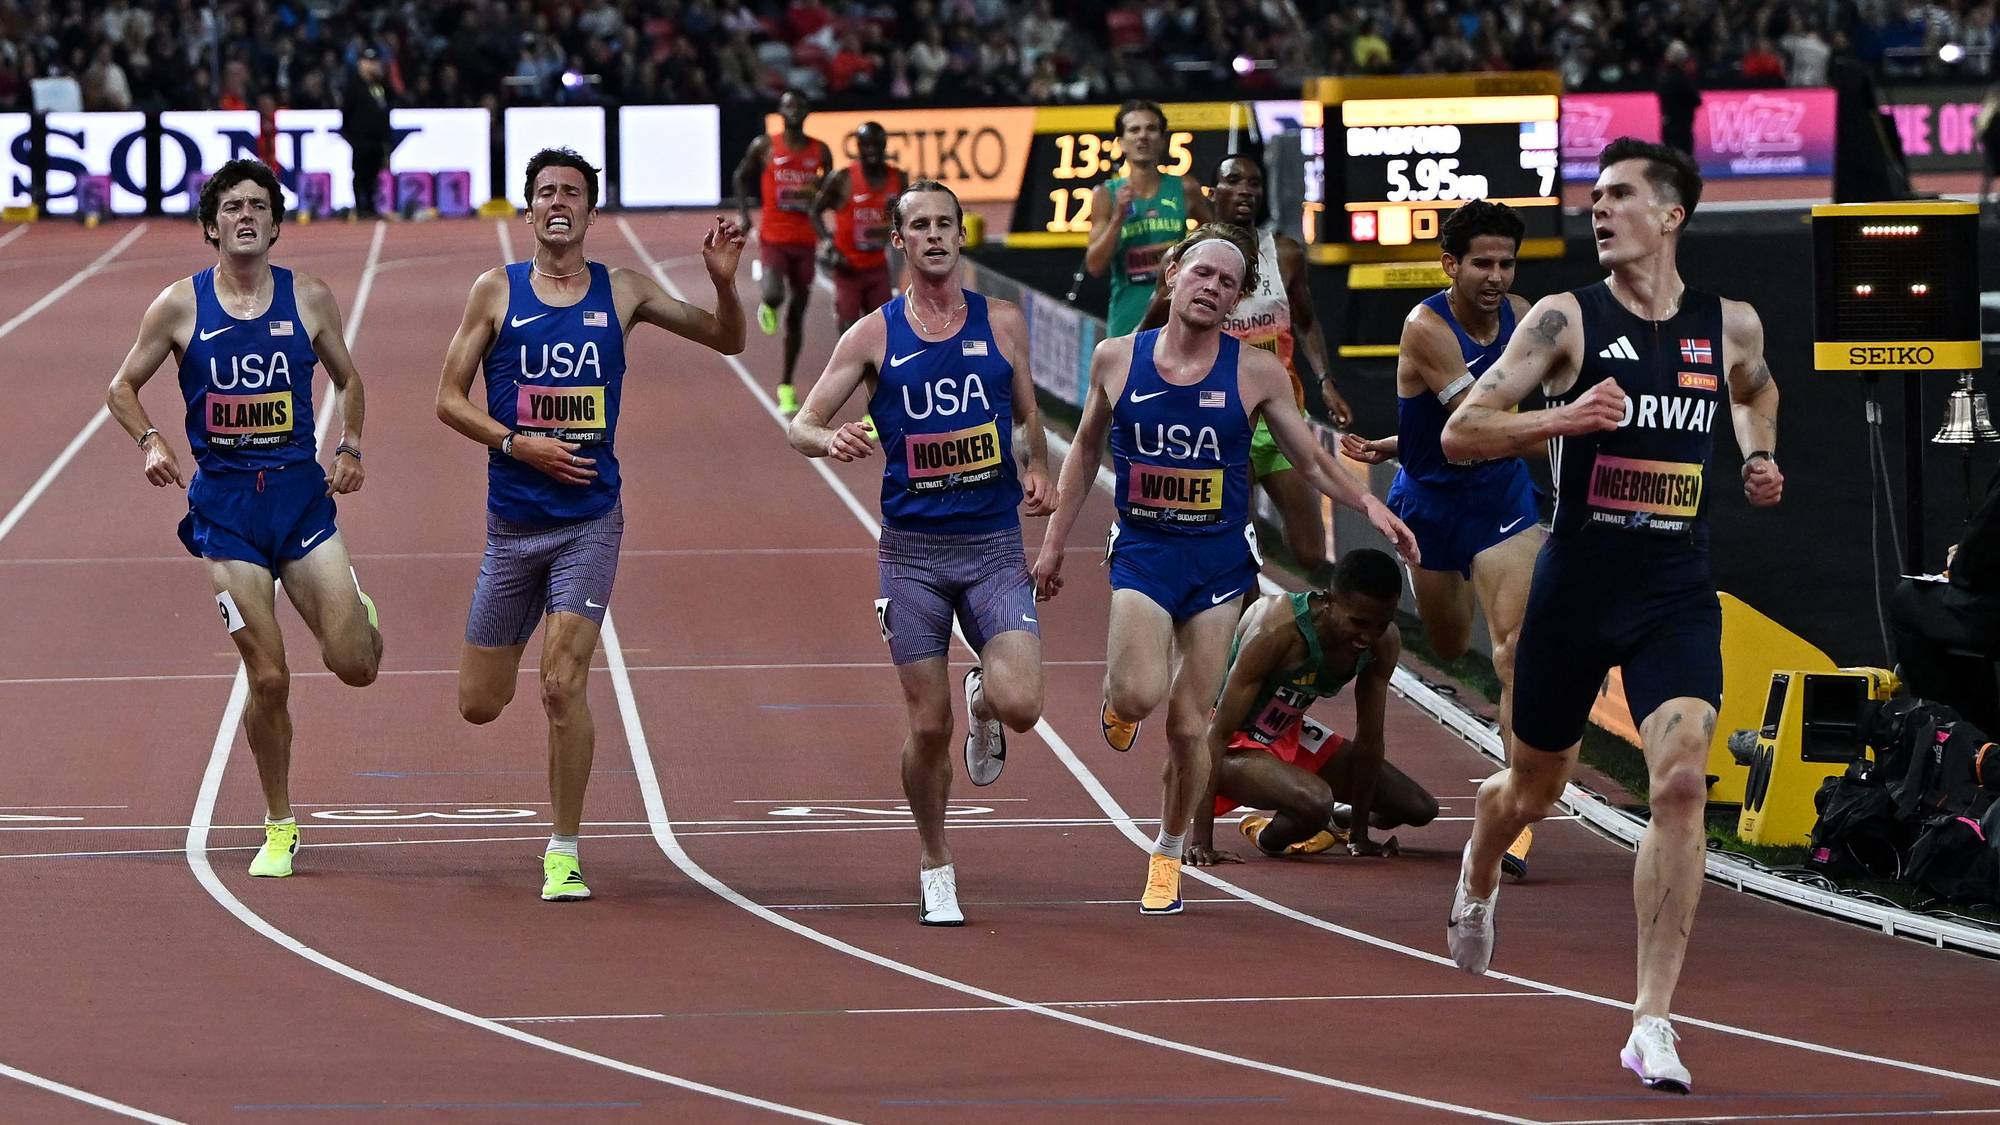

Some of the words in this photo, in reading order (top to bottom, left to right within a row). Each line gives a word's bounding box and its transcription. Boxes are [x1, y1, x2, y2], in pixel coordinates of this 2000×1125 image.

[1222, 313, 1276, 331] URUNDI
[520, 341, 601, 378] USA
[1849, 346, 1935, 365] SEIKO
[210, 351, 291, 389] USA
[529, 394, 596, 421] YOUNG
[902, 374, 990, 419] USA
[212, 400, 287, 427] BLANKS
[1615, 394, 1718, 433] ORWAY
[211, 436, 235, 446] ULTIMATE
[253, 435, 281, 445] BUDAPEST
[565, 432, 595, 441] BUDAPEST
[1134, 422, 1221, 461] USA
[912, 433, 995, 469] HOCKER
[915, 480, 943, 490] ULTIMATE
[962, 471, 991, 484] BUDAPEST
[1141, 472, 1212, 504] WOLFE
[1593, 464, 1700, 508] INGEBRIGTSEN
[1131, 507, 1158, 519] ULTIMATE
[1177, 513, 1208, 523] BUDAPEST
[1592, 511, 1627, 525] ULTIMATE
[1649, 518, 1684, 531] BUDAPEST
[219, 600, 230, 629] 9
